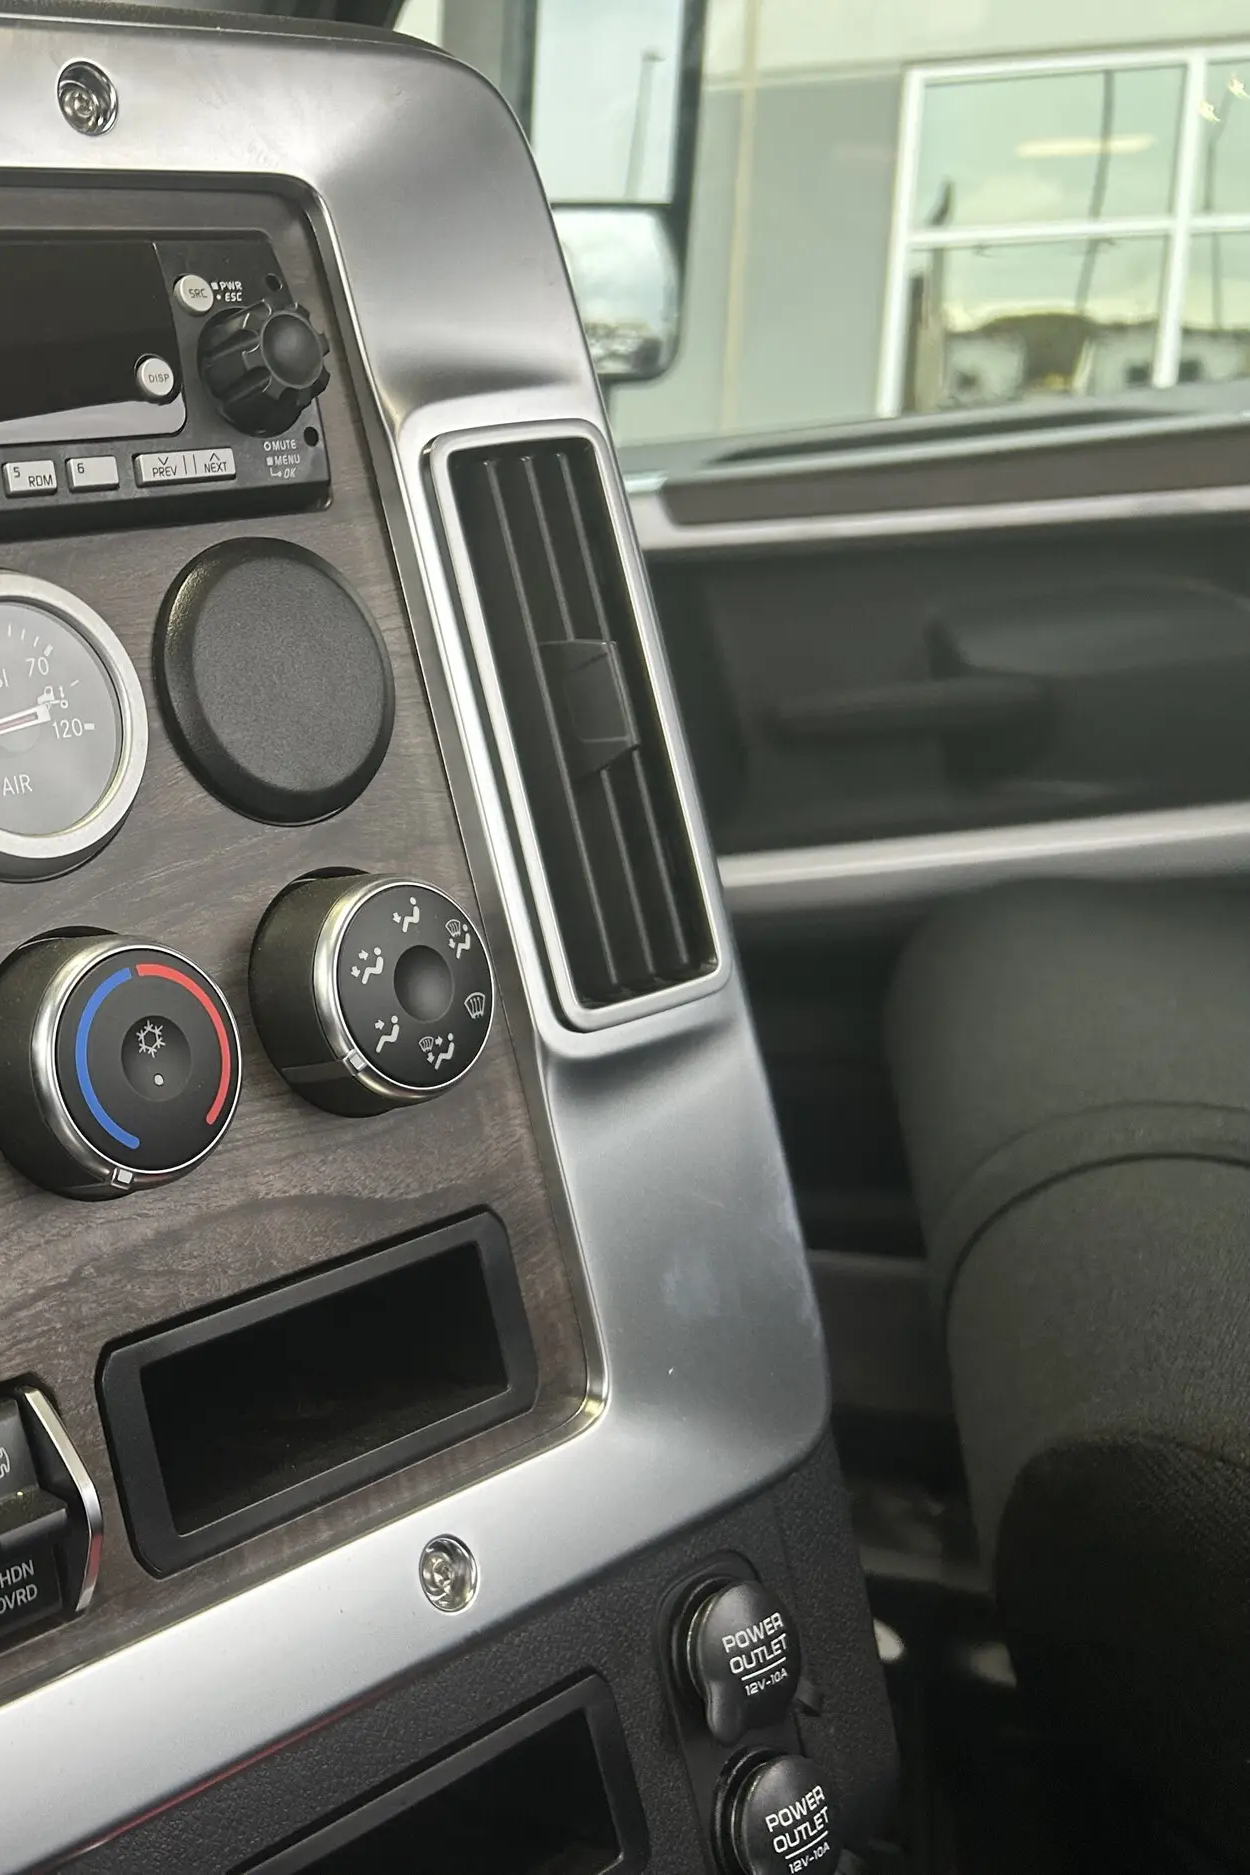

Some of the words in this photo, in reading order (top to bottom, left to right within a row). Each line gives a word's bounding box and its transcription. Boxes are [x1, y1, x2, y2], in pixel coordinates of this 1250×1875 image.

[219, 281, 243, 291] PWR
[188, 288, 208, 299] SRC
[224, 292, 243, 302] ESC
[148, 373, 170, 383] DISP
[271, 439, 297, 451] MUTE
[274, 454, 301, 466] MENU
[13, 466, 21, 478] 5
[77, 463, 85, 475] 6
[152, 465, 178, 477] PREV
[204, 461, 229, 473] NEXT
[283, 467, 297, 479] OK
[28, 475, 54, 488] RDM
[25, 656, 49, 677] 70
[52, 718, 83, 739] 120
[2, 774, 33, 797] AIR
[721, 1611, 784, 1653] POWER
[729, 1633, 788, 1675] OUTLET
[744, 1667, 789, 1696] 12V-10A
[765, 1785, 826, 1833] POWER
[772, 1806, 830, 1854] OUTLET
[788, 1841, 831, 1874] 12V-10A
